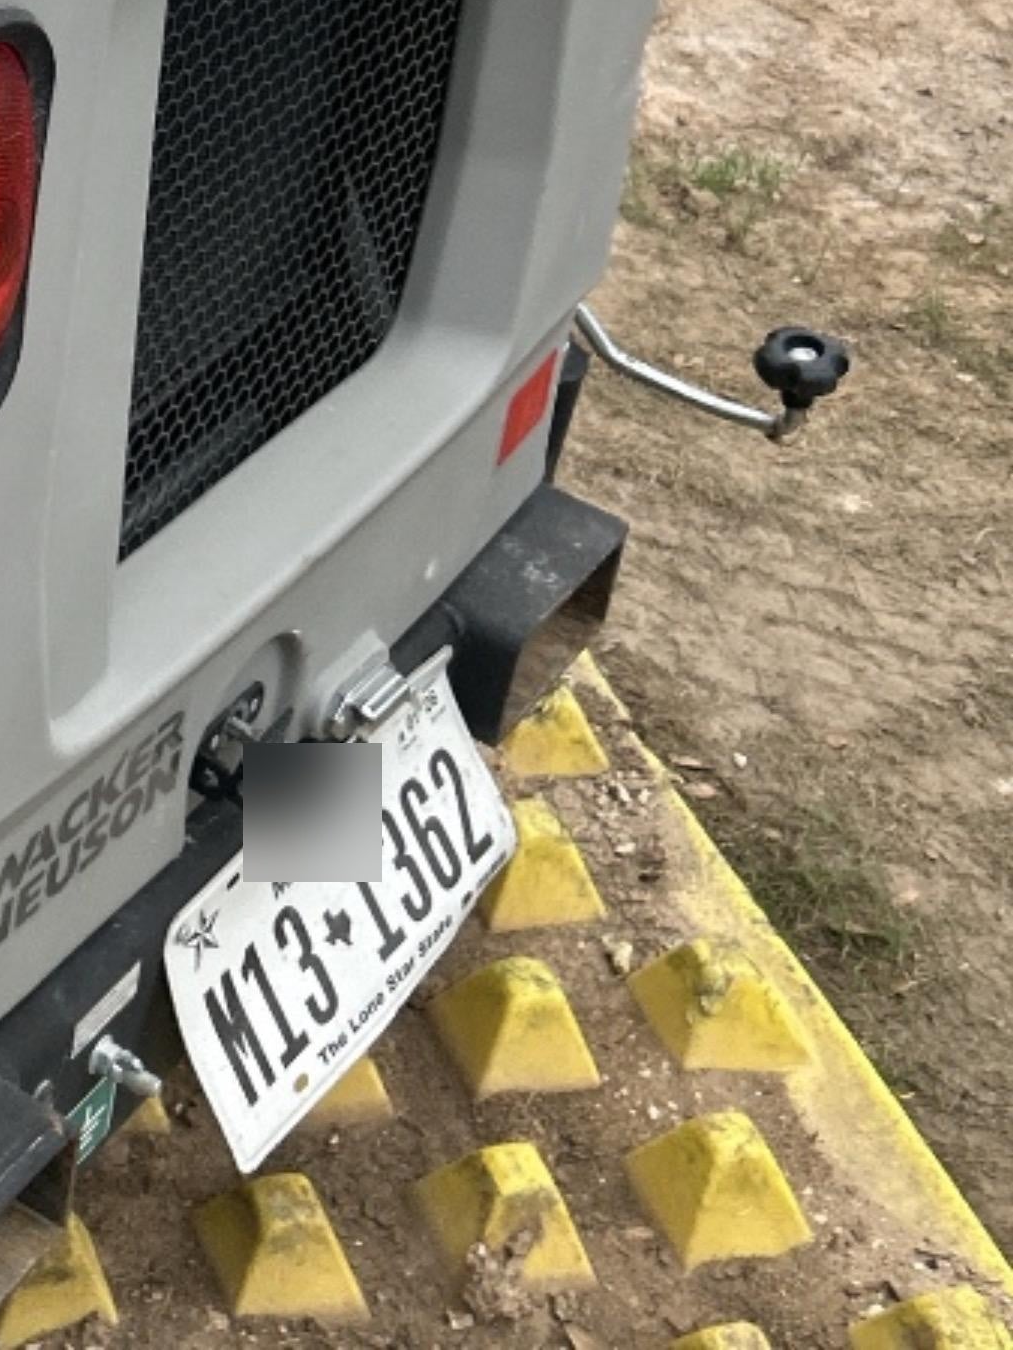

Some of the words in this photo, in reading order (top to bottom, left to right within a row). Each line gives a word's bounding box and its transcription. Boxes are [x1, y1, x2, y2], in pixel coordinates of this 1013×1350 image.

[317, 1032, 349, 1065] The
[348, 991, 385, 1034] Lone
[386, 956, 416, 992] Star
[418, 914, 454, 958] State
